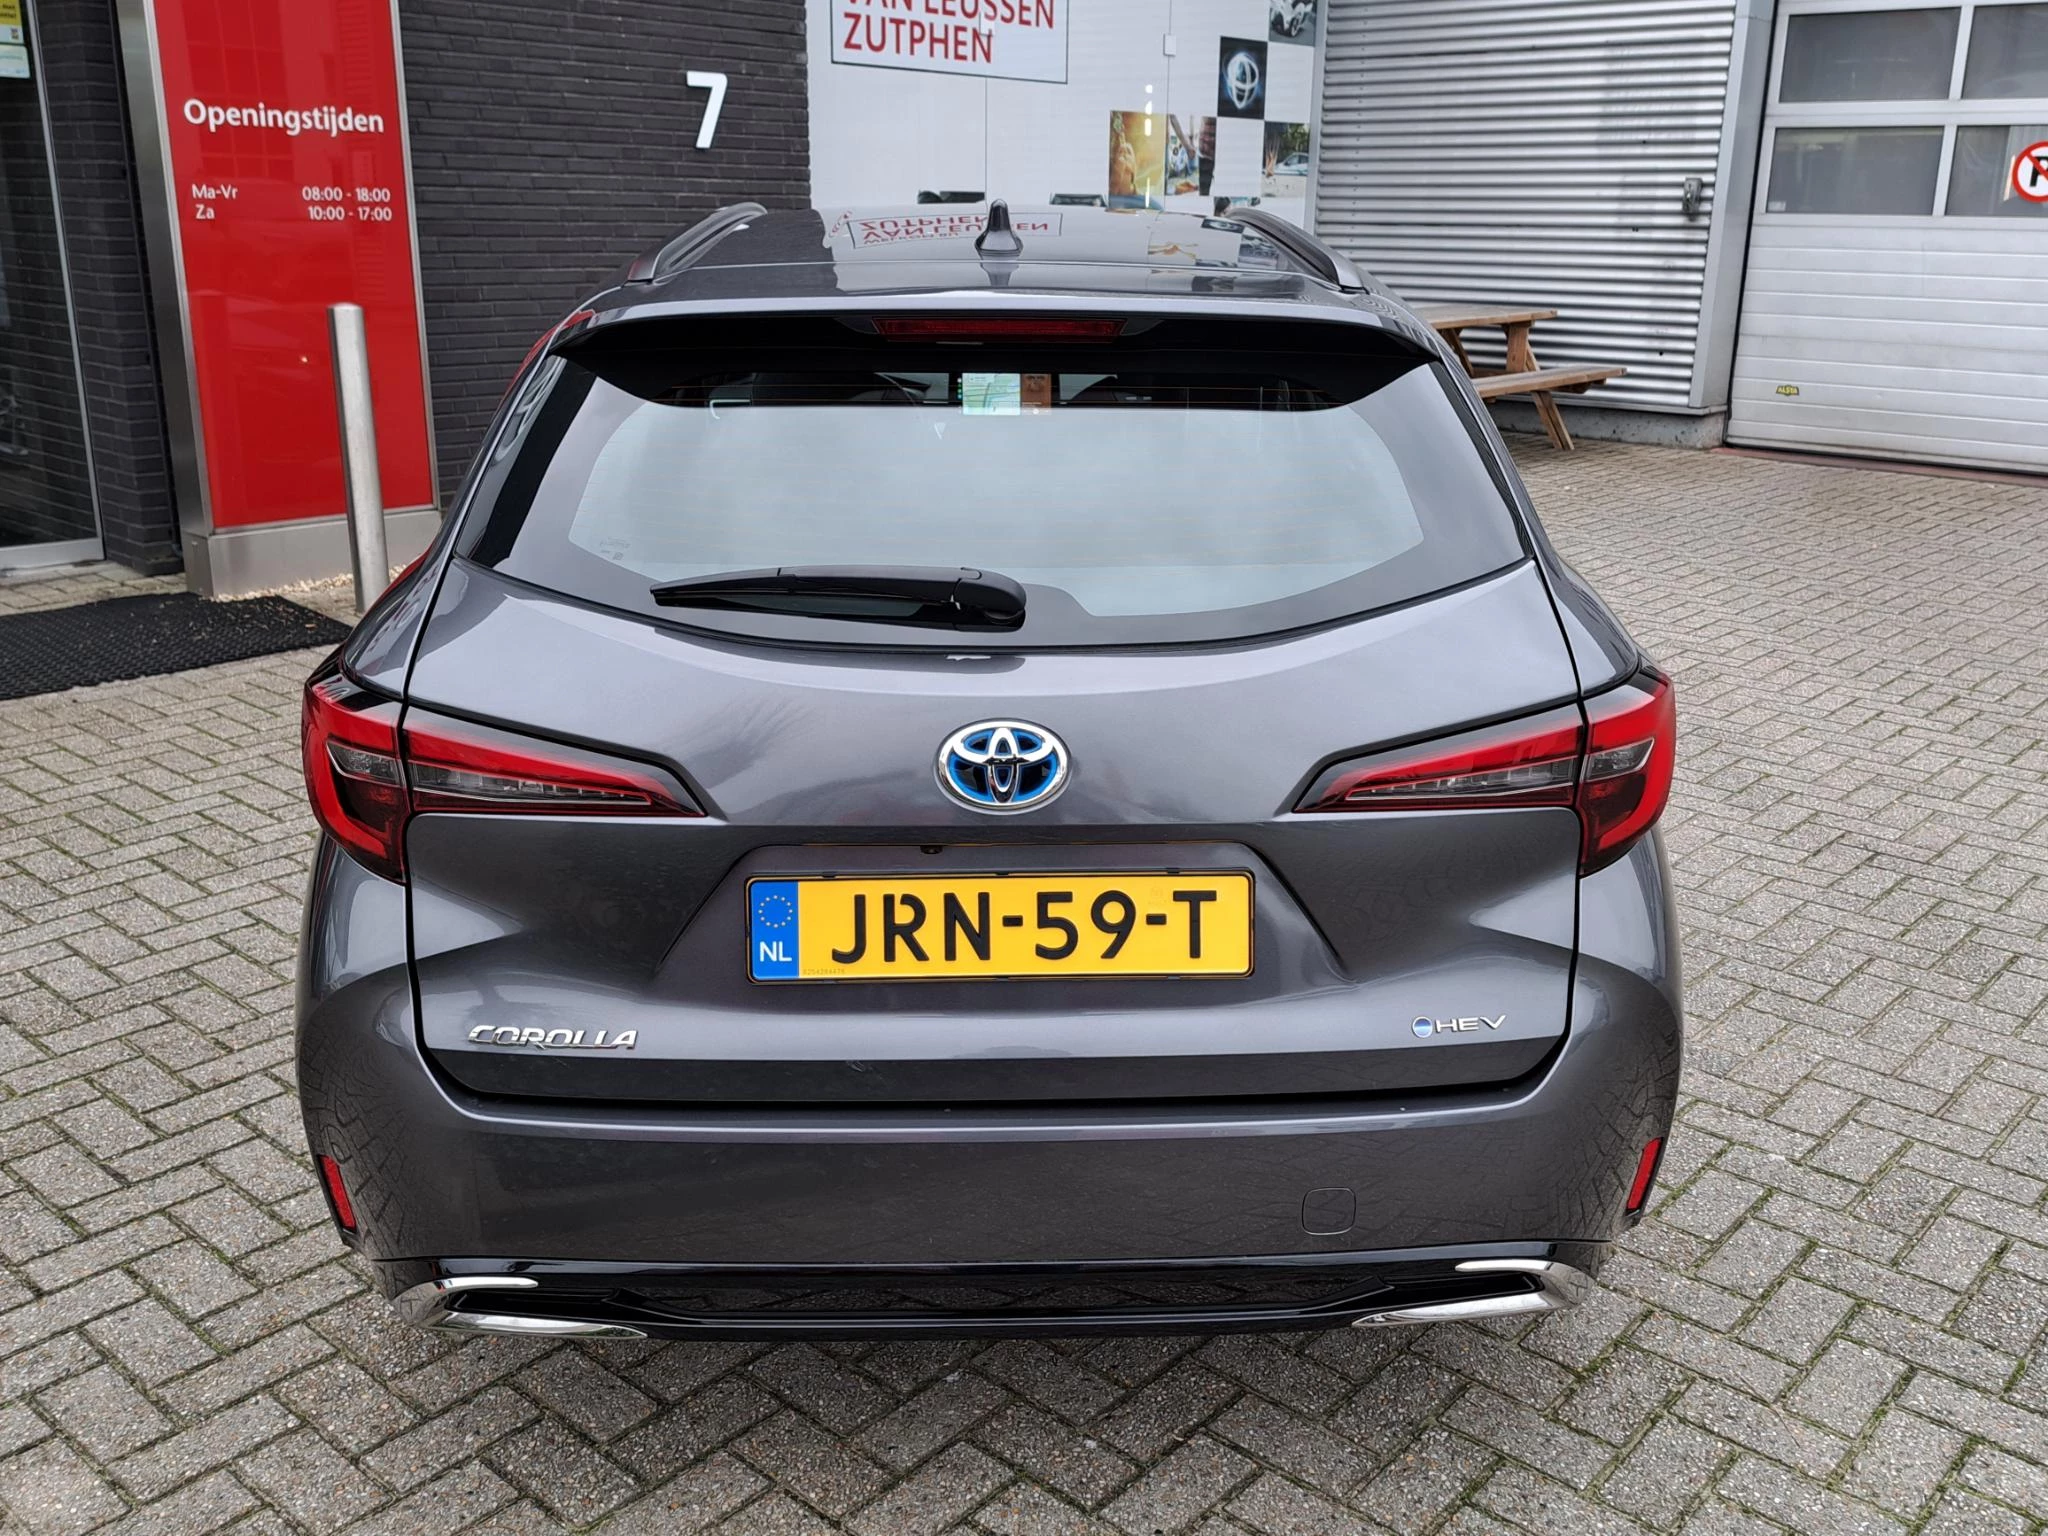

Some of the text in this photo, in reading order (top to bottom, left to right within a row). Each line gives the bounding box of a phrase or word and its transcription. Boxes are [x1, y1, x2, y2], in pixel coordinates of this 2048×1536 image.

[844, 12, 992, 63] ZUTPHEN
[183, 98, 384, 137] Openingstijden
[686, 70, 728, 148] 7
[191, 184, 238, 199] Ma-Vr
[302, 186, 343, 201] 08:00
[355, 187, 391, 202] 18:00
[195, 204, 215, 219] Za
[308, 206, 345, 220] 10:00
[358, 207, 392, 221] 17:00
[831, 889, 1217, 964] JRN-59-T
[759, 941, 792, 962] NL
[1435, 1014, 1507, 1033] HEV
[467, 1024, 640, 1050] COROLLA
